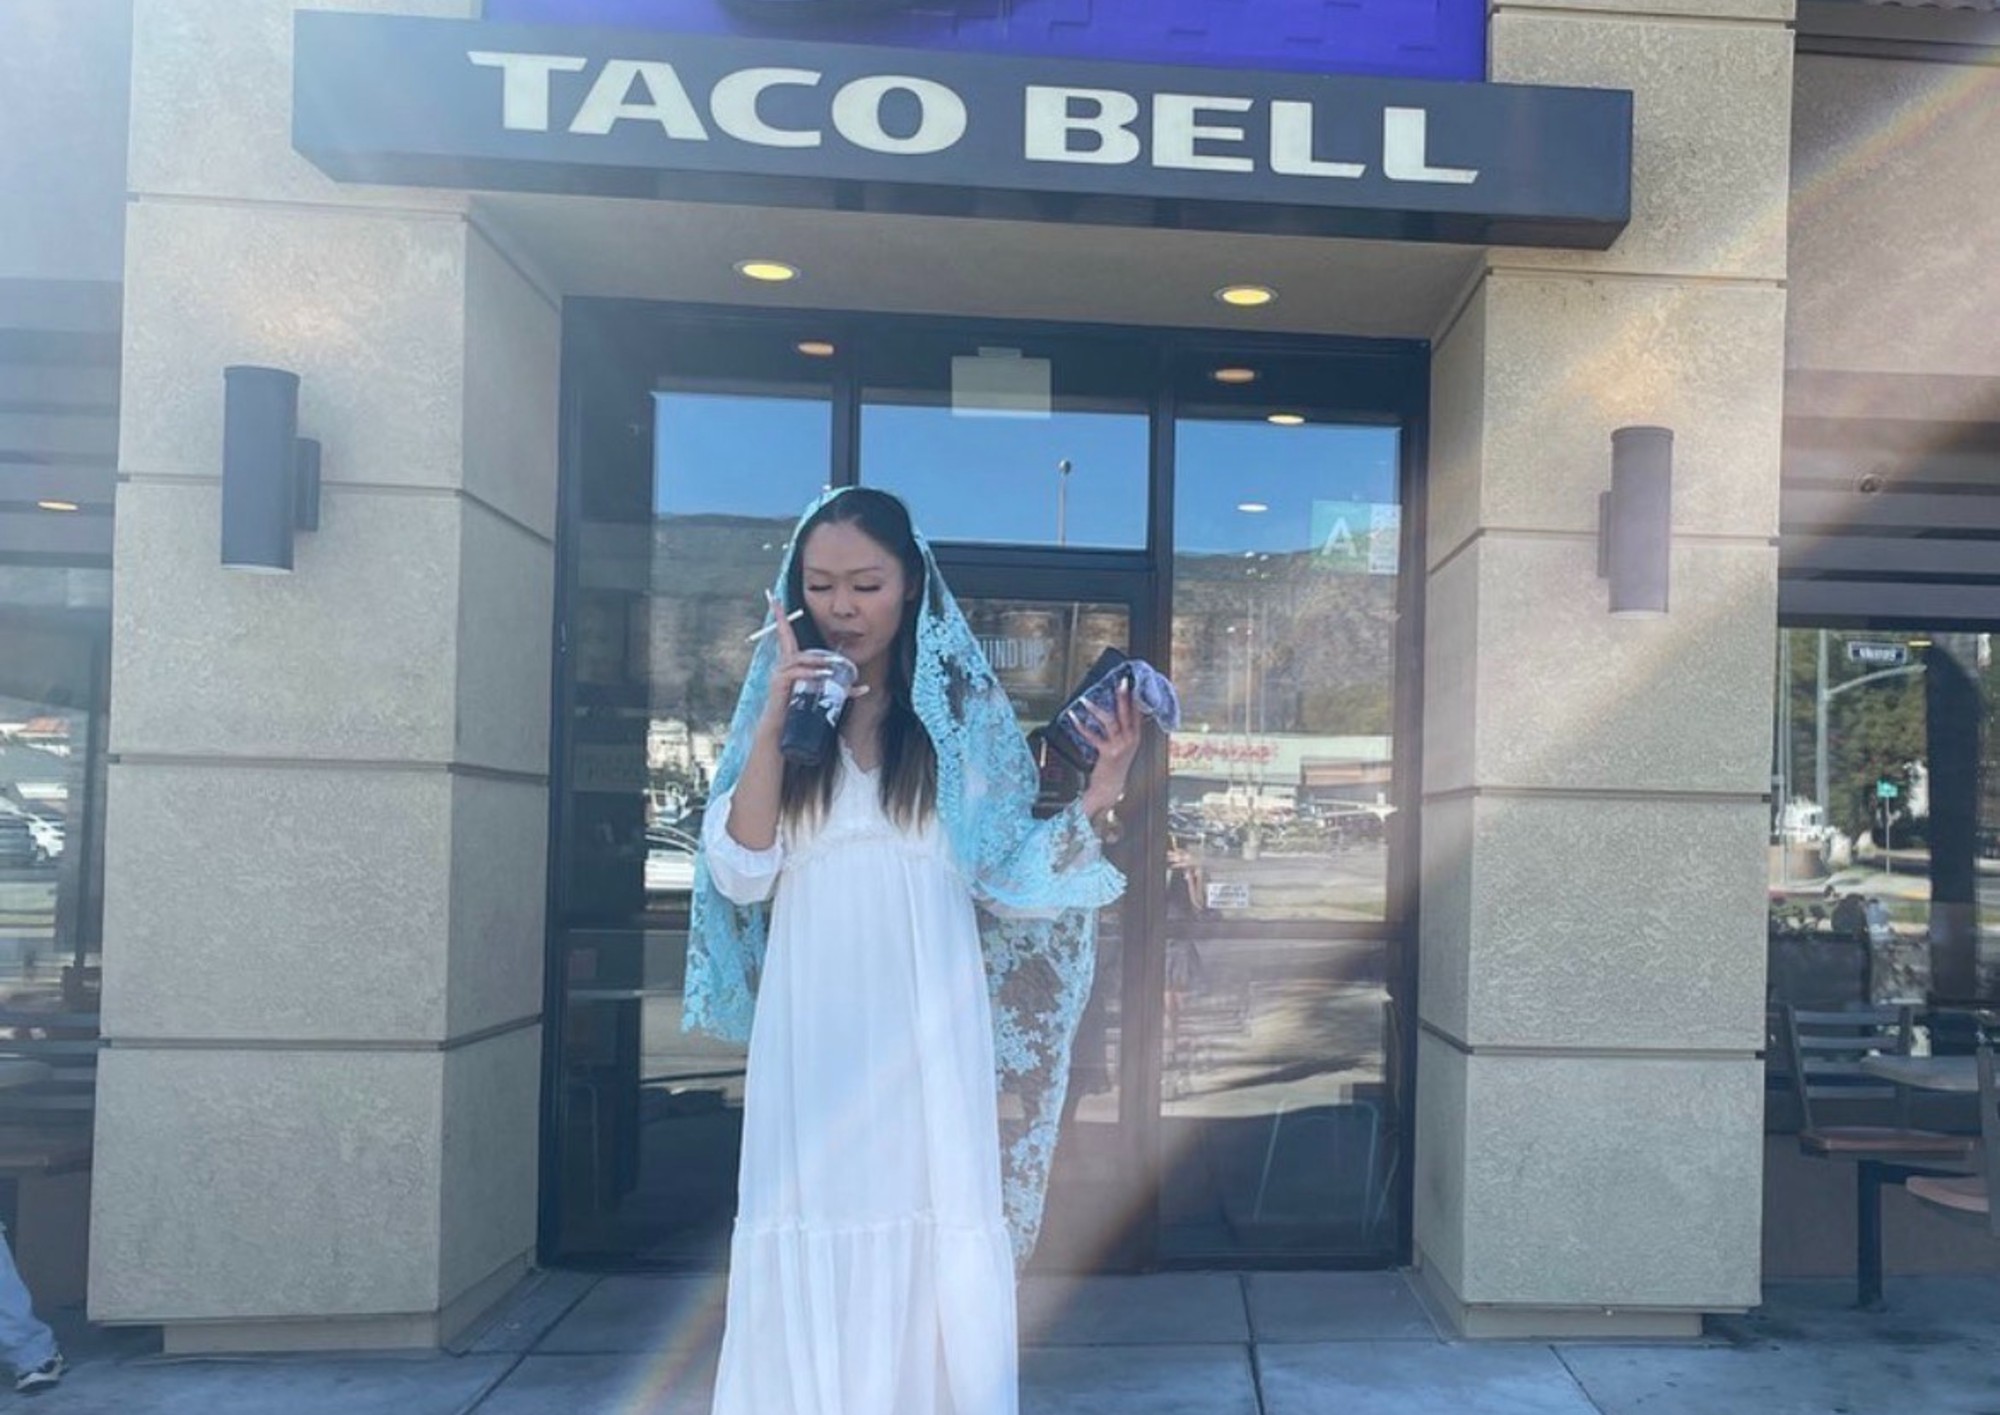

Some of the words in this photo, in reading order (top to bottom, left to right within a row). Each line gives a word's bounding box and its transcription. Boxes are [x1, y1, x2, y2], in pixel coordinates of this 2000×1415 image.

[467, 50, 967, 155] TACO
[1025, 85, 1479, 184] BELL
[1321, 516, 1358, 558] A
